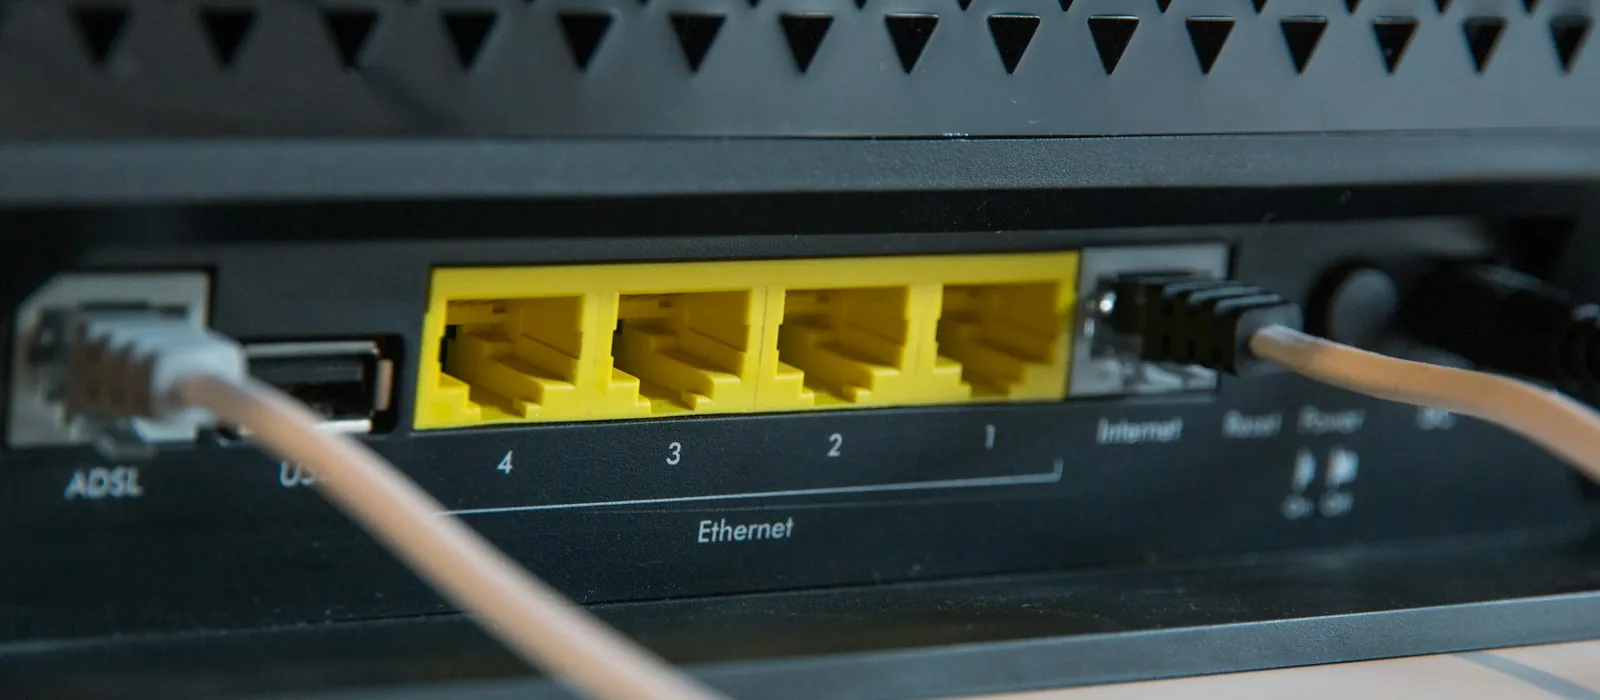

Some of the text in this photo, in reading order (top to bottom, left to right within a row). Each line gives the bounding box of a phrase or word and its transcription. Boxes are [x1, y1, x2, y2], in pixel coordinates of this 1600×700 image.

[985, 424, 996, 449] 1
[1097, 416, 1183, 444] Internet
[666, 441, 682, 466] 3
[827, 433, 843, 457] 2
[497, 450, 513, 475] 4
[65, 466, 142, 499] ADSL
[698, 516, 795, 544] Ethernet
